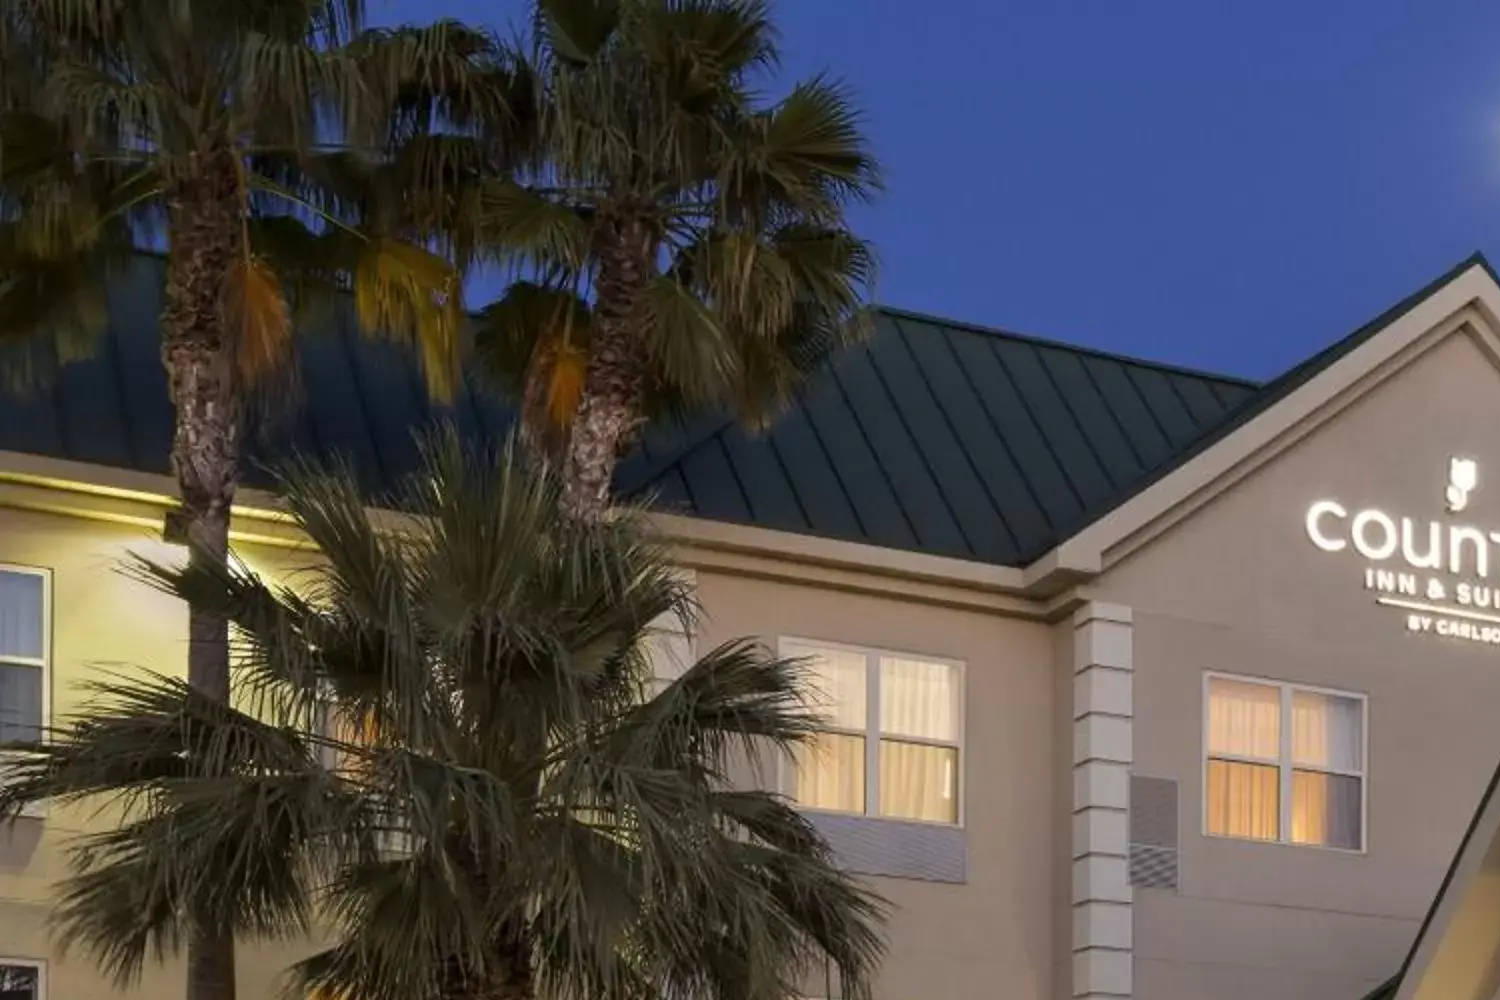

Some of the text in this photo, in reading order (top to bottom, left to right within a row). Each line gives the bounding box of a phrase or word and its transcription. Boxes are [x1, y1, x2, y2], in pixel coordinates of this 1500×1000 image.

[1364, 568, 1417, 595] INN
[1427, 577, 1446, 600] &
[1407, 615, 1432, 632] BY
